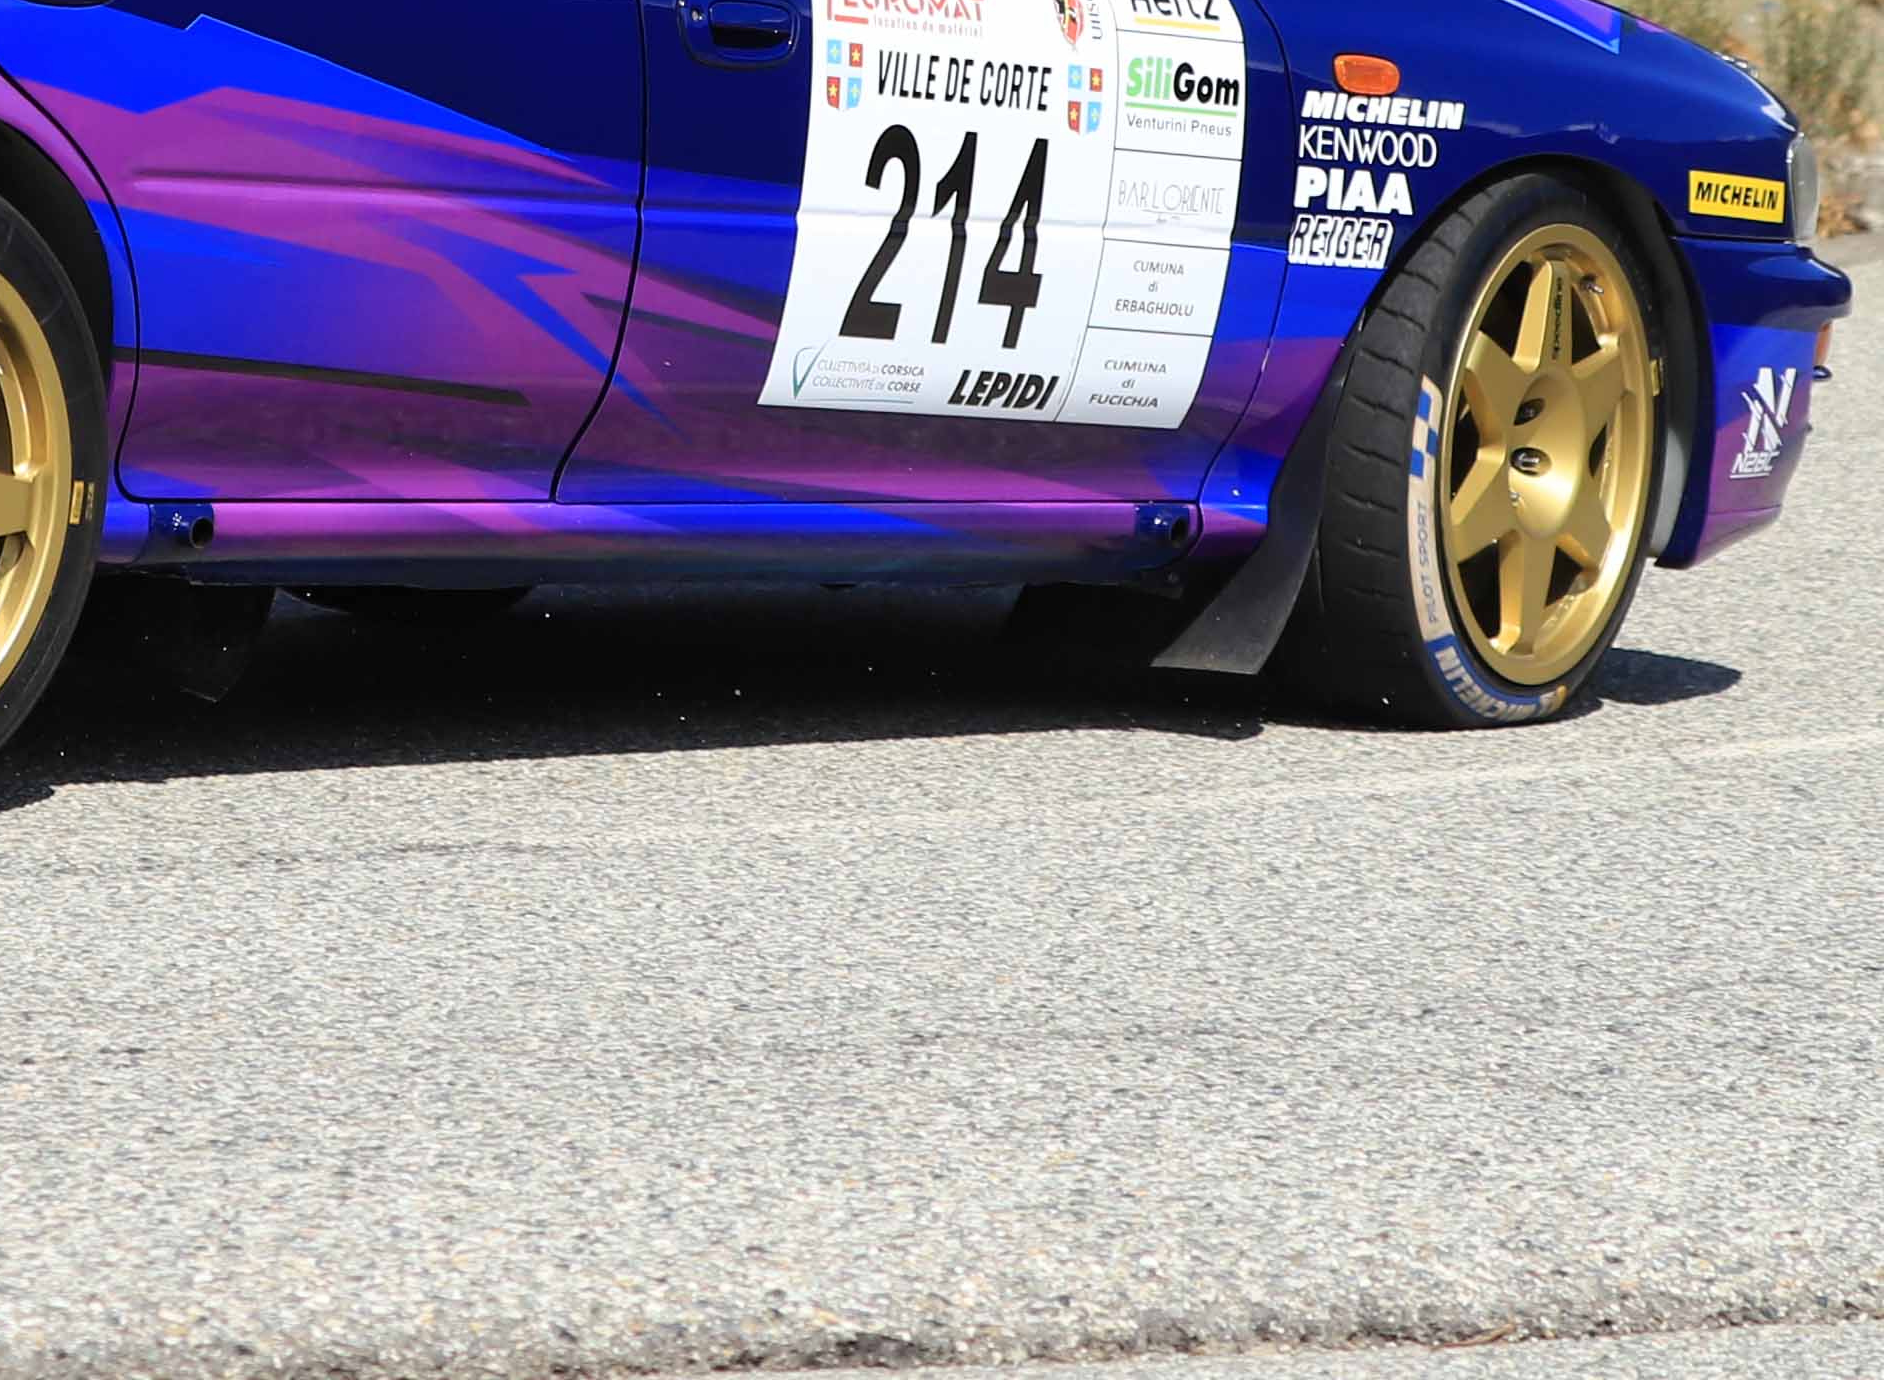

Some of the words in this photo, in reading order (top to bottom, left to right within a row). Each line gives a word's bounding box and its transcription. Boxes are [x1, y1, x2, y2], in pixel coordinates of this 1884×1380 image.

[878, 49, 940, 100] VILLE
[944, 57, 974, 104] DE
[980, 60, 1053, 112] CORTE
[1125, 56, 1240, 107] SiliGom
[1126, 113, 1187, 133] Venturini
[1191, 120, 1232, 137] Pneus
[1301, 90, 1465, 130] MICHELIN
[1298, 124, 1438, 168] KENWOOD
[1293, 165, 1414, 216] PIAA
[1695, 181, 1779, 210] MICHELIN
[838, 123, 1049, 350] 214
[1289, 213, 1394, 270] REIGER
[1133, 259, 1185, 276] CUMUNA
[1148, 281, 1158, 293] di
[880, 363, 925, 377] CORSICA
[1104, 359, 1168, 374] CUMUNA
[1121, 379, 1136, 389] di
[887, 381, 922, 394] CORSE
[947, 369, 1060, 411] LEPIDI
[1088, 393, 1159, 408] FUCICHJA
[1417, 500, 1430, 570] SPORT
[1420, 572, 1438, 625] PILOT
